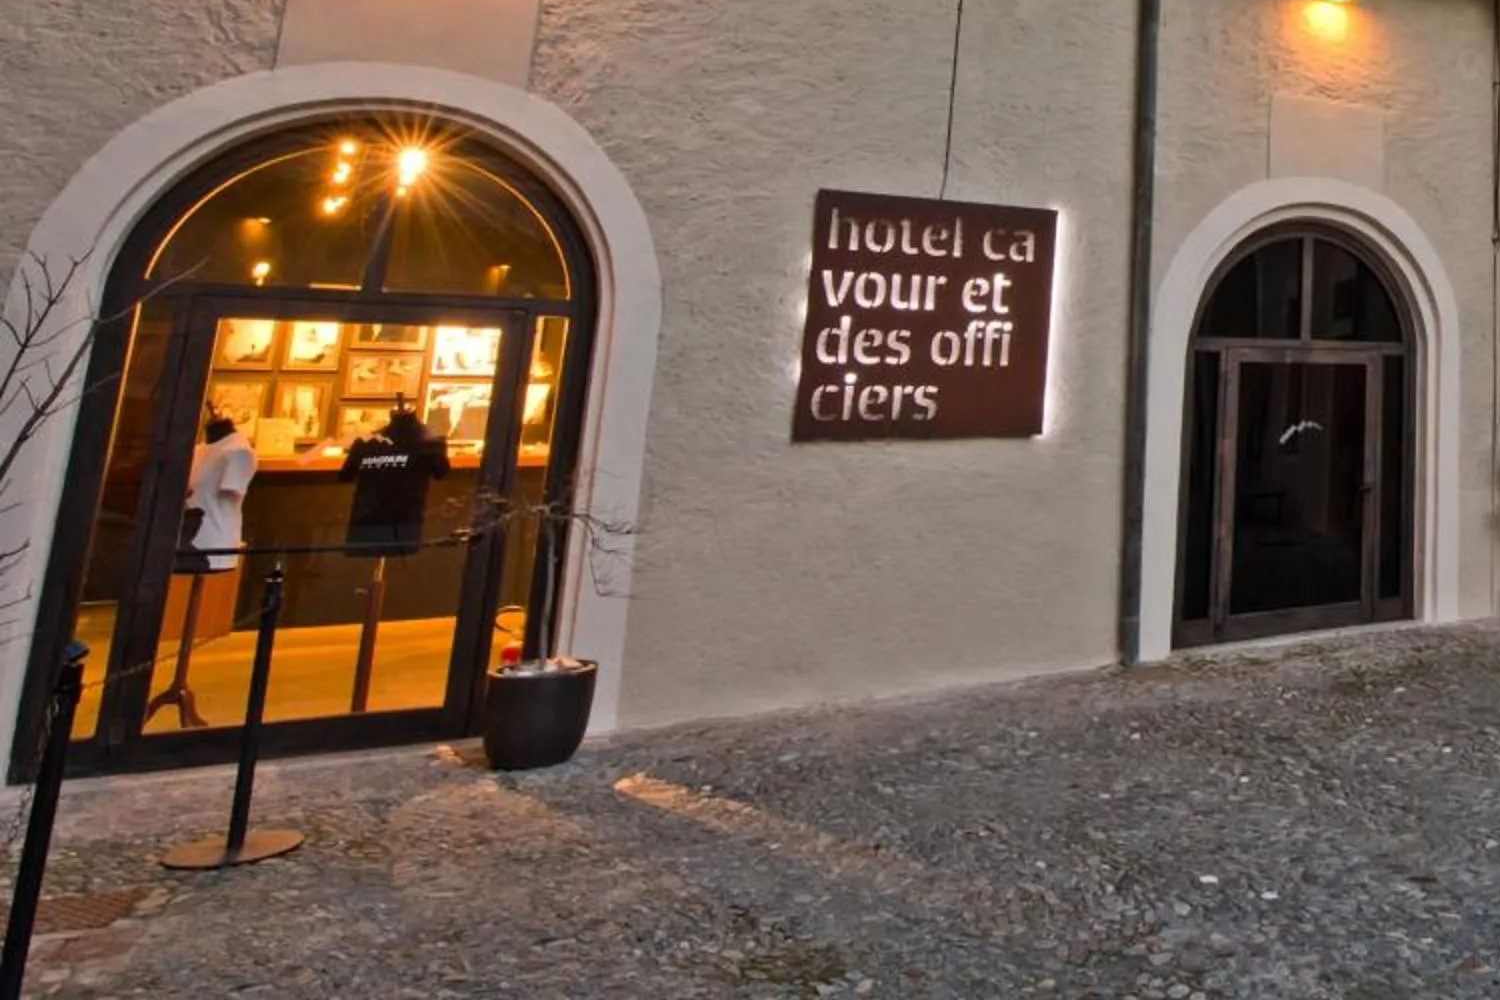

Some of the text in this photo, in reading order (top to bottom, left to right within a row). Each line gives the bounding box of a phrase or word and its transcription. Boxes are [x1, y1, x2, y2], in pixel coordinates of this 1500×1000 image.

[828, 207, 1035, 263] hotel ca
[822, 269, 1013, 313] vour et
[815, 315, 1013, 367] des offi
[810, 372, 939, 421] ciers
